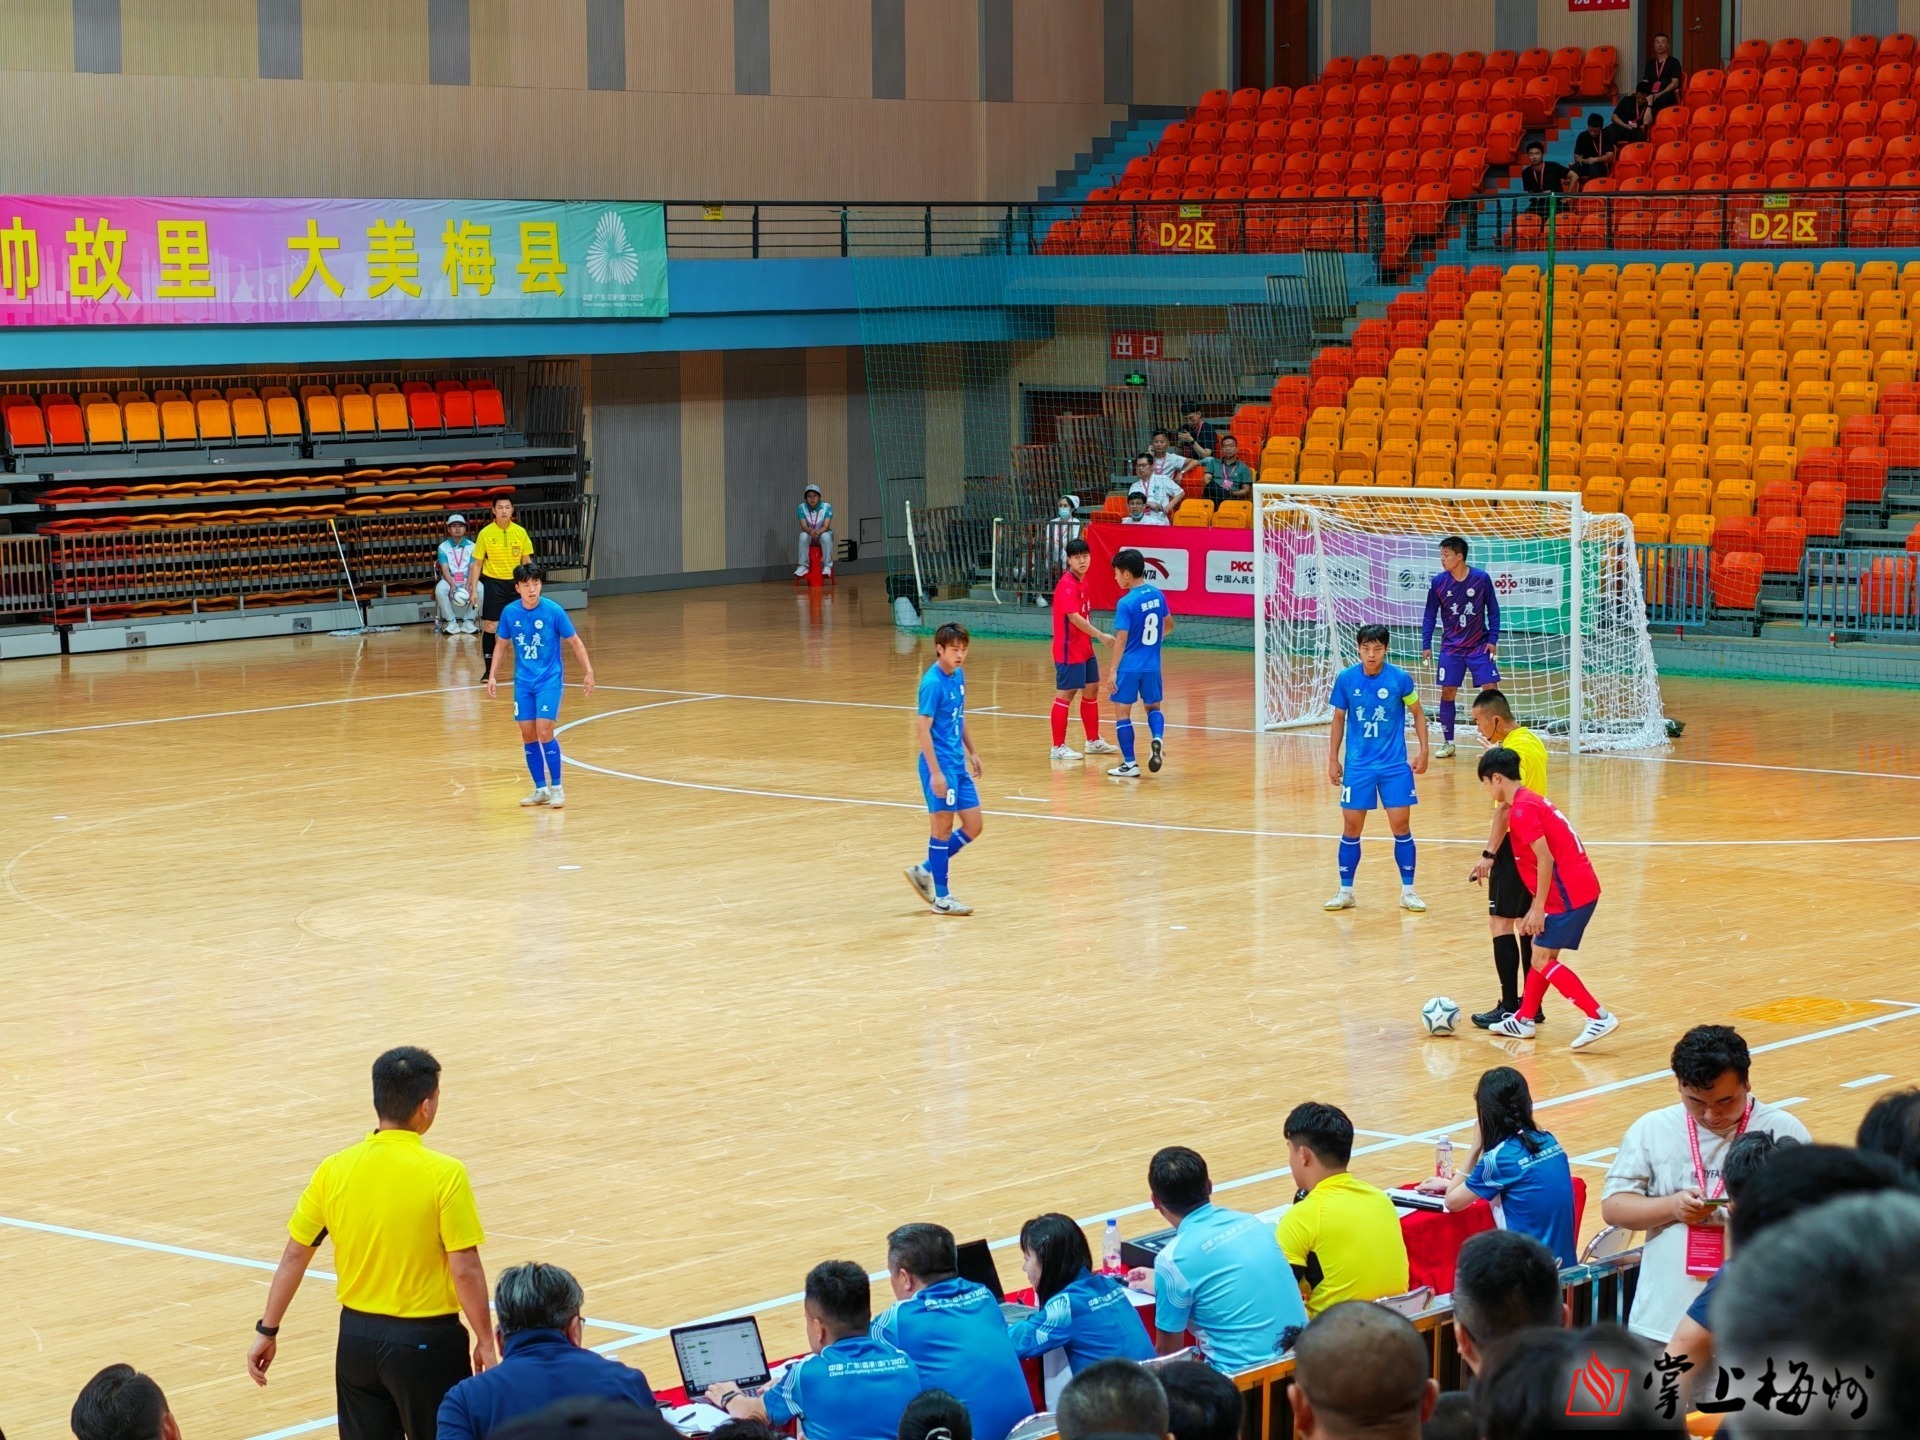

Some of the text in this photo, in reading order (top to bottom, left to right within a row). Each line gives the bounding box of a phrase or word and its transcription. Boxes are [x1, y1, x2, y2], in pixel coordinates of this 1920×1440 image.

[1750, 211, 1818, 242] D2区
[1160, 222, 1217, 250] D2区
[287, 218, 568, 299] 大美梅县
[1117, 334, 1158, 356] 出口
[1142, 569, 1157, 581] NTA
[1142, 612, 1158, 646] 8
[1459, 614, 1467, 628] 9
[524, 645, 538, 659] 23
[1438, 667, 1446, 682] 9
[1363, 721, 1379, 738] 21
[945, 788, 956, 806] 6
